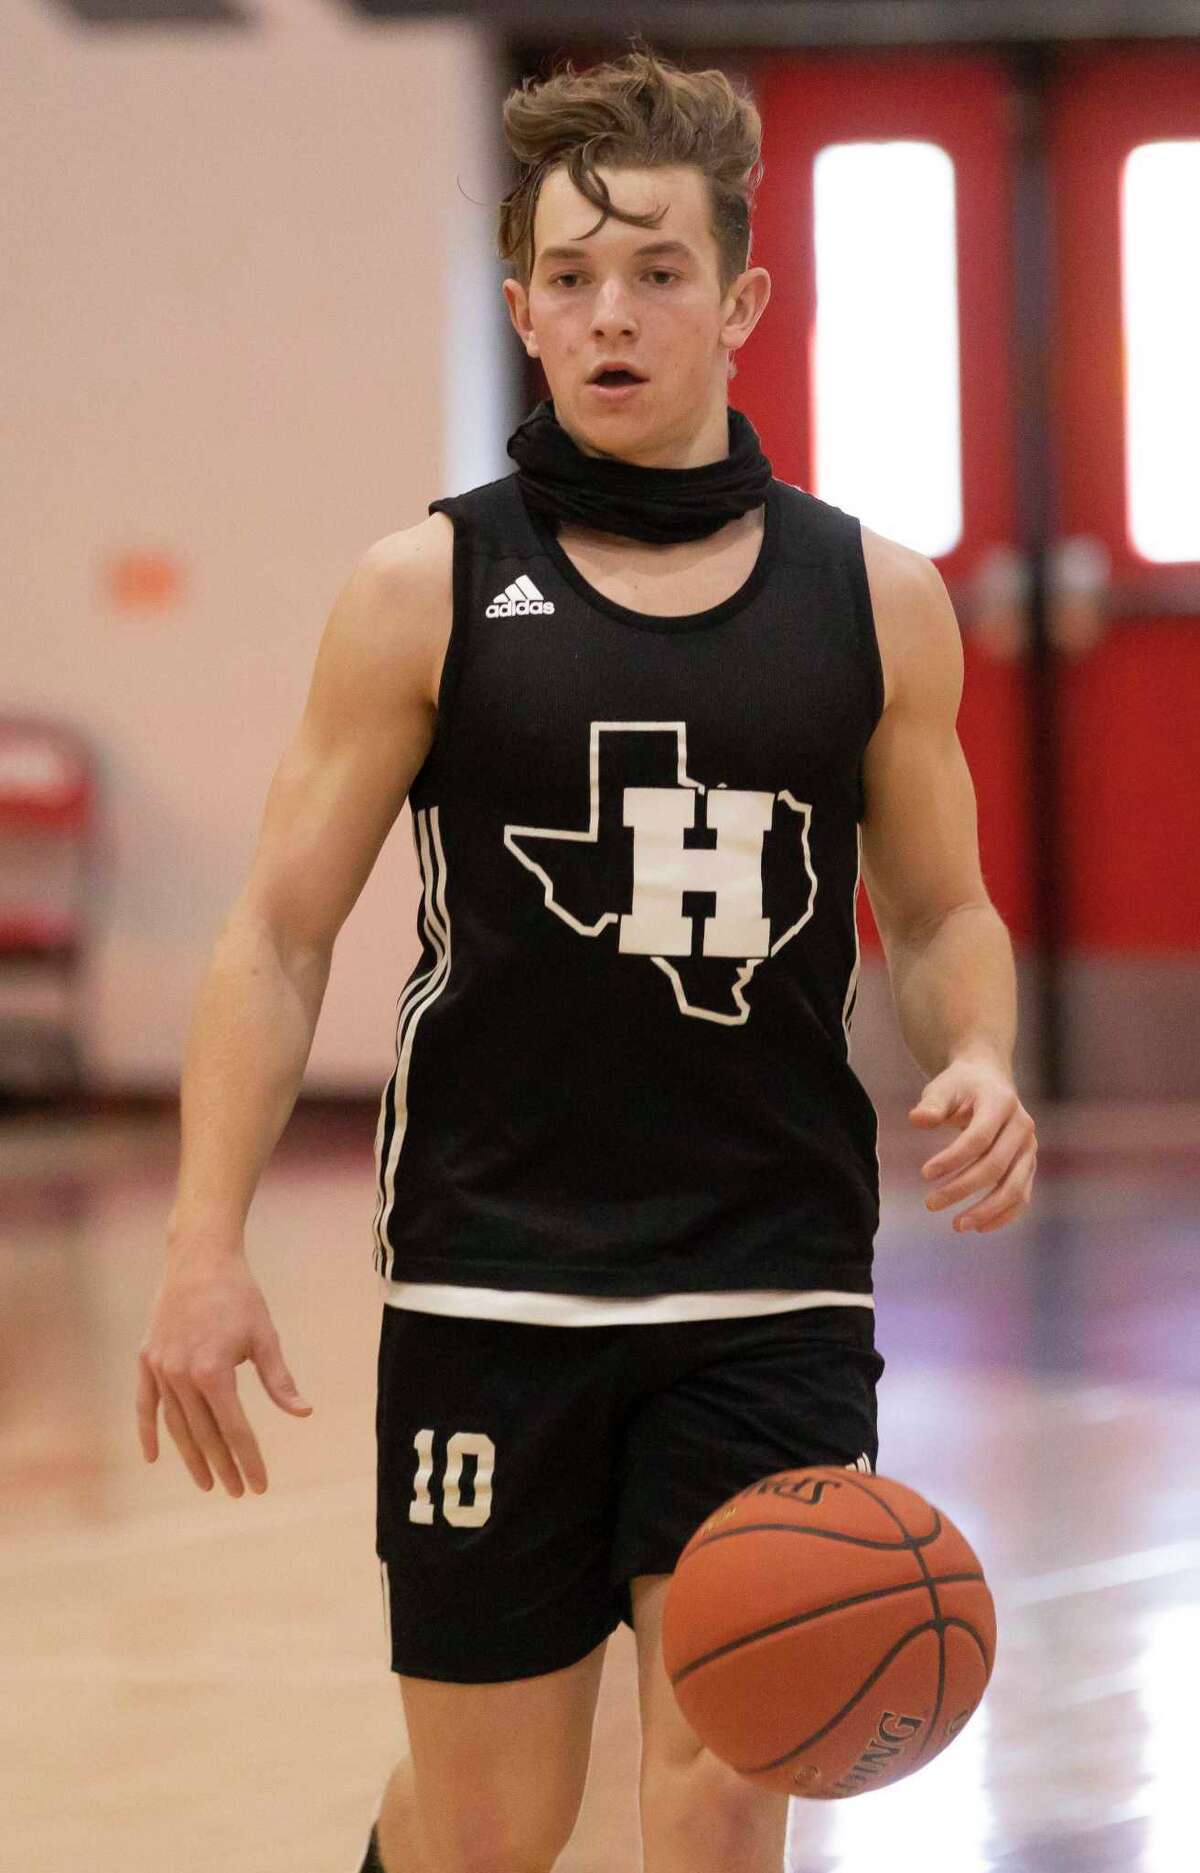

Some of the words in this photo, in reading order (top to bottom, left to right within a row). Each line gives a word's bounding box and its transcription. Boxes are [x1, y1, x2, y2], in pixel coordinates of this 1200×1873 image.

[485, 600, 555, 619] adidas
[618, 787, 775, 958] H
[409, 1429, 496, 1528] 10
